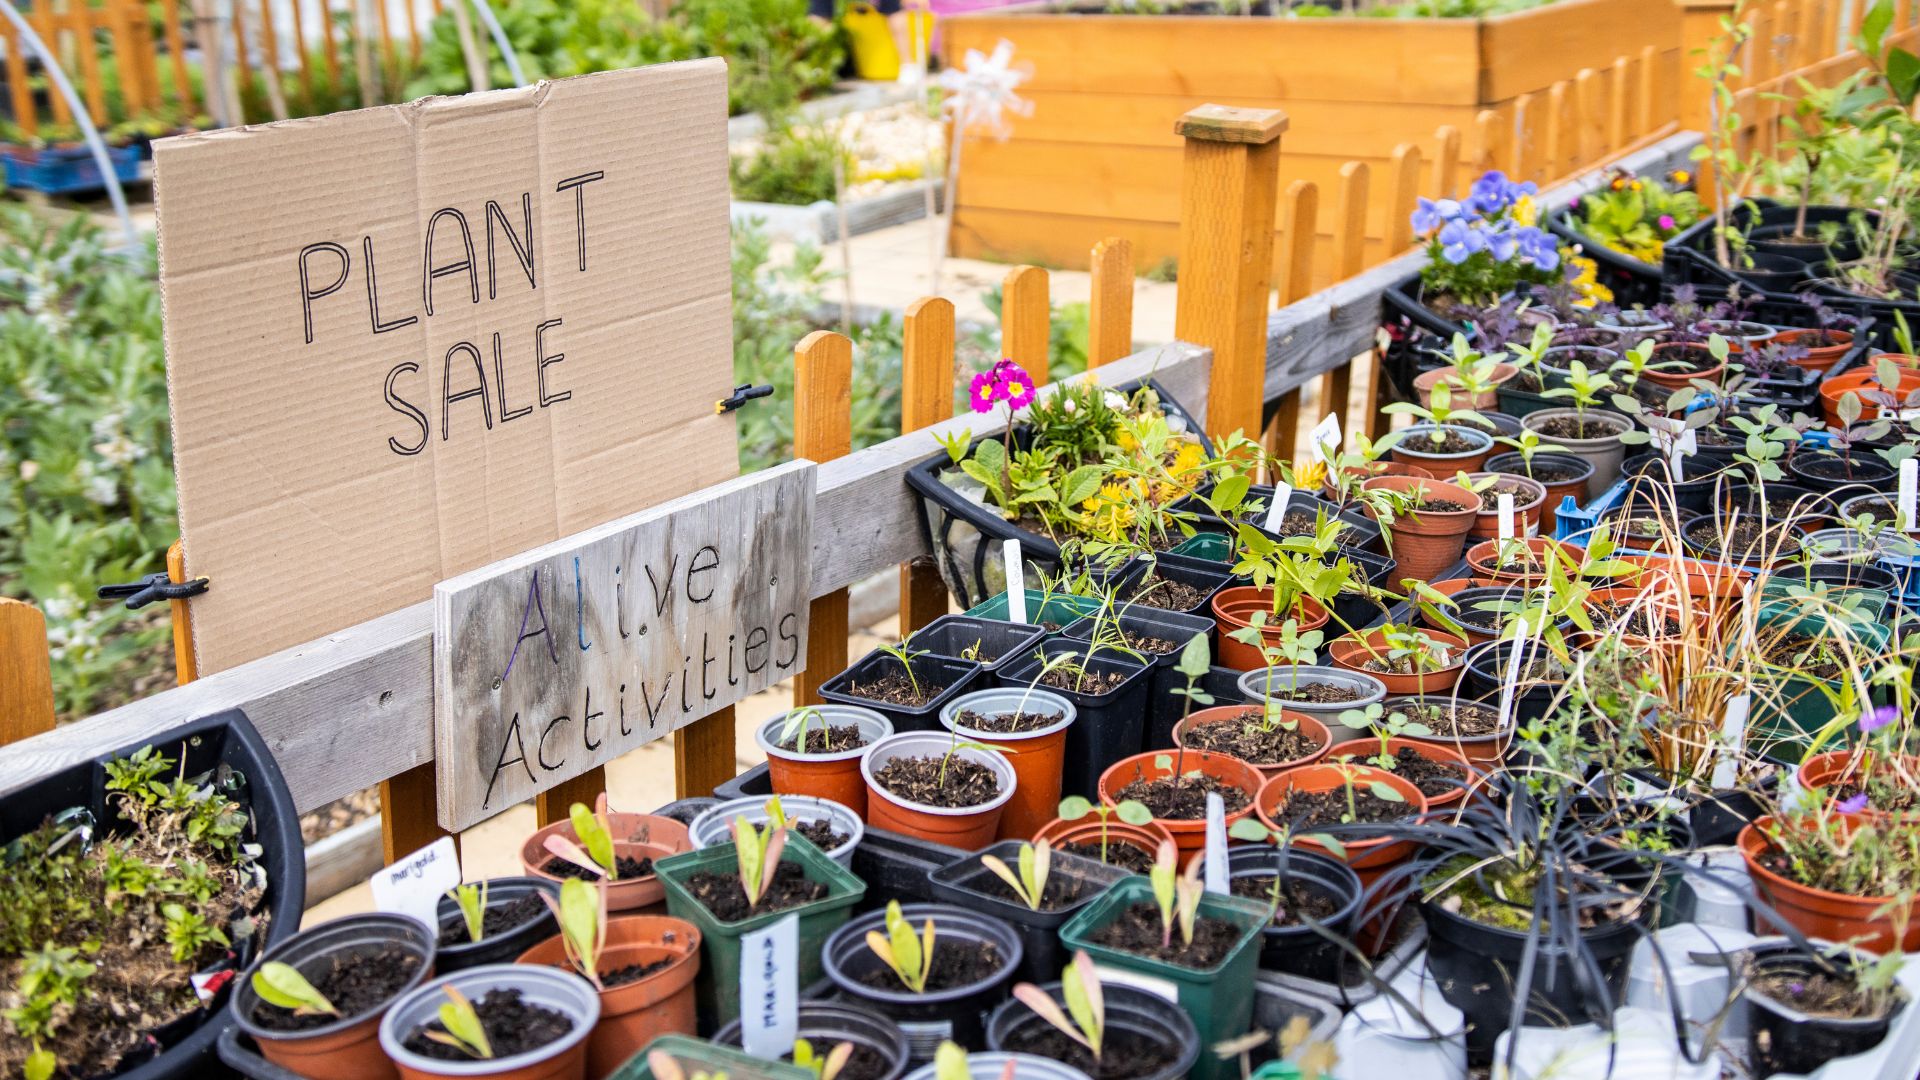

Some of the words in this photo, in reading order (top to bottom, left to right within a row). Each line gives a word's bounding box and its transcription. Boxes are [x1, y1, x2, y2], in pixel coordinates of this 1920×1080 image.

[299, 170, 604, 344] PLANT
[384, 317, 572, 456] SALE
[502, 545, 720, 681] Alive
[482, 612, 799, 810] Activities
